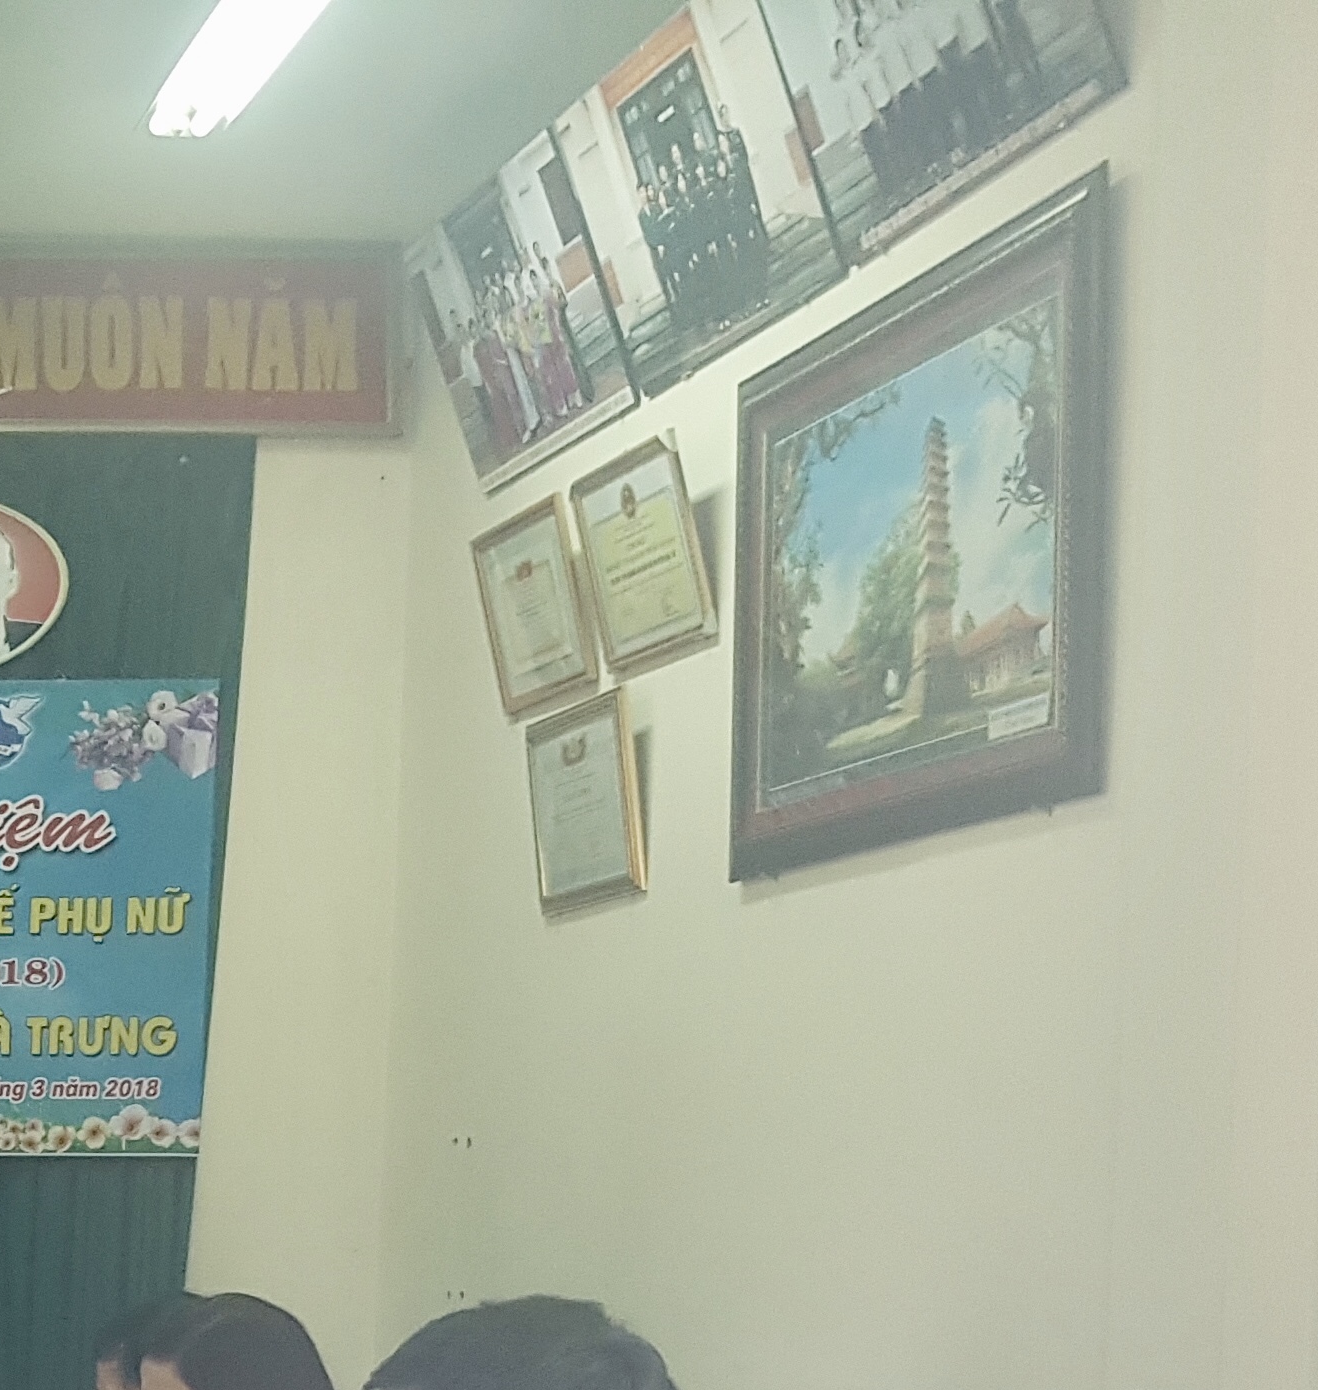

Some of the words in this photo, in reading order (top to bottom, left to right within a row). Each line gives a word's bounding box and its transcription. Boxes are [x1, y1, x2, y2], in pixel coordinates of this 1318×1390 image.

[205, 276, 357, 391] NĂM
[29, 896, 114, 943] PHỤ
[126, 886, 191, 936] NỮ
[26, 1014, 178, 1057] TRƯNG
[30, 1077, 47, 1100] 3
[51, 1076, 99, 1100] năm
[103, 1076, 161, 1101] 2018
